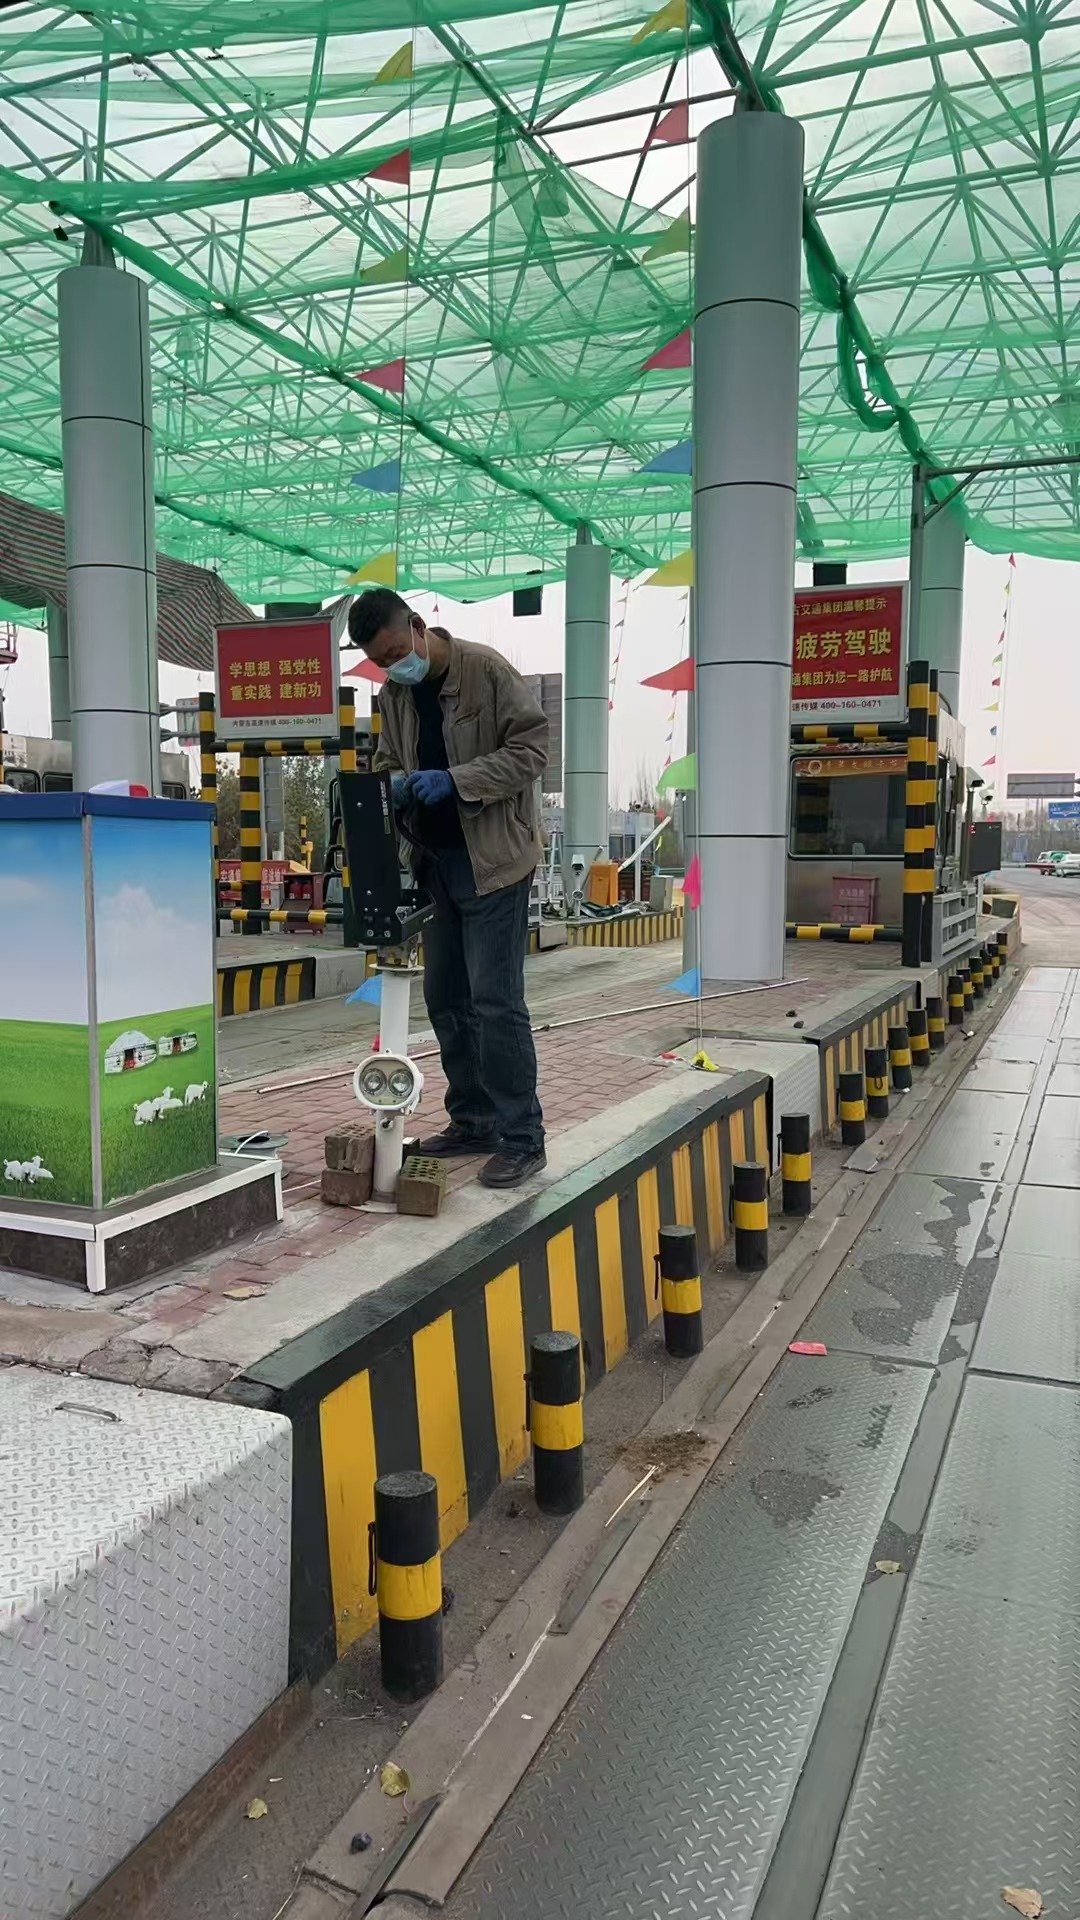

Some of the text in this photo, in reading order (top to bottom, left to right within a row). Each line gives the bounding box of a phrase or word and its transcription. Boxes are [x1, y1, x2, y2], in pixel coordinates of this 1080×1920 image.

[796, 627, 892, 660] 疲劳驾驶
[229, 657, 321, 678] 学思想 强党性
[230, 681, 322, 701] 重实践 建新功
[820, 700, 881, 709] 400-160-0471
